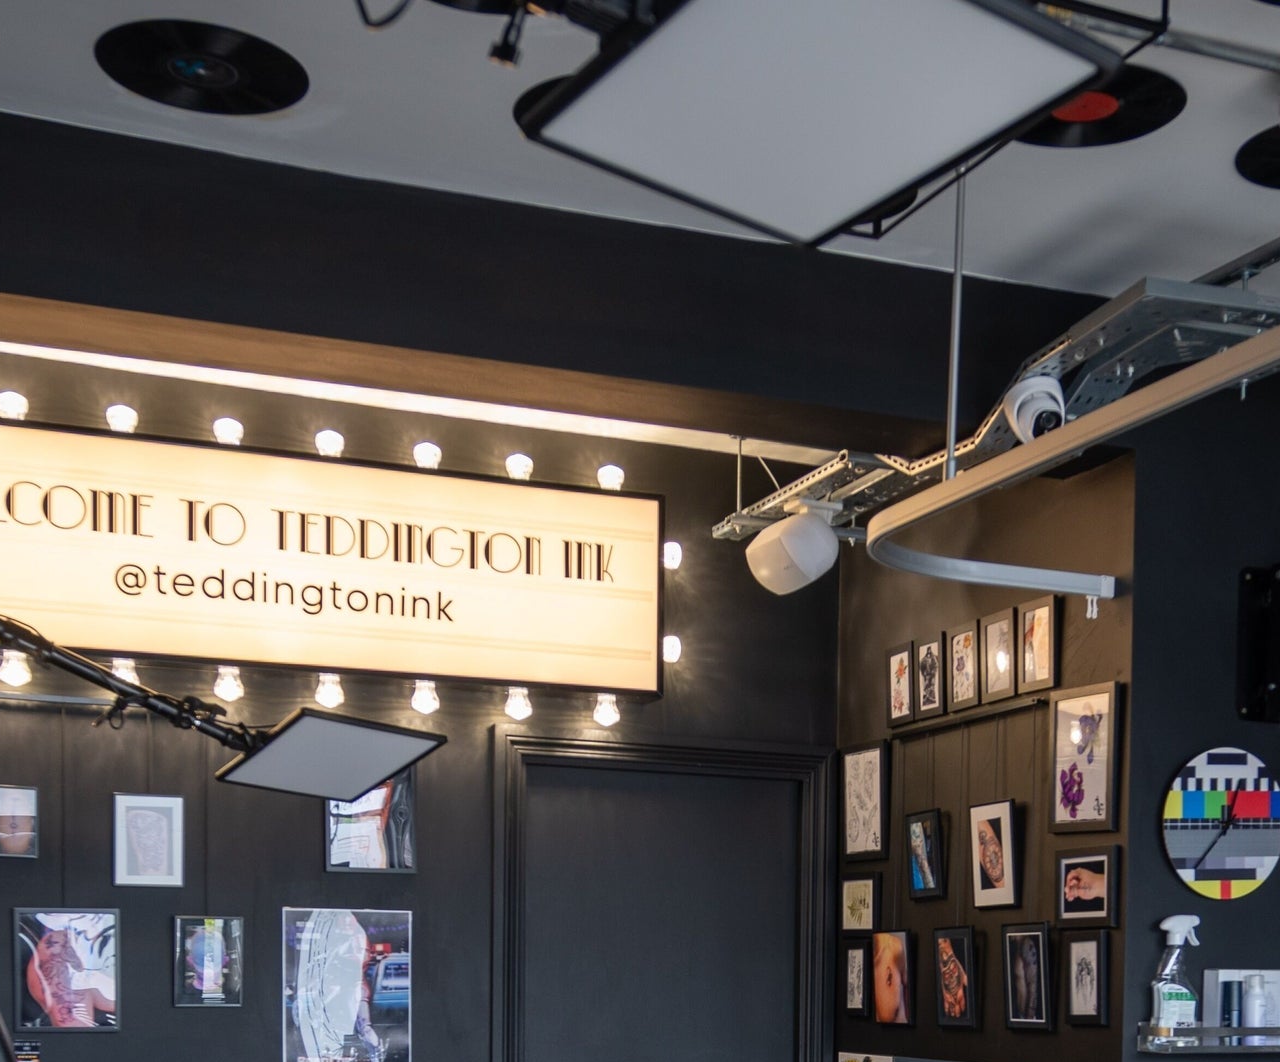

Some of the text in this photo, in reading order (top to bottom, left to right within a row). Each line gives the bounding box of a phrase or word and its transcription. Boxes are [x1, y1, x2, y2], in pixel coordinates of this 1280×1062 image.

[179, 498, 246, 545] TO
[271, 509, 541, 575] TEDDINGTON
[563, 539, 614, 583] INK
[115, 564, 454, 622] @teddingtonink
